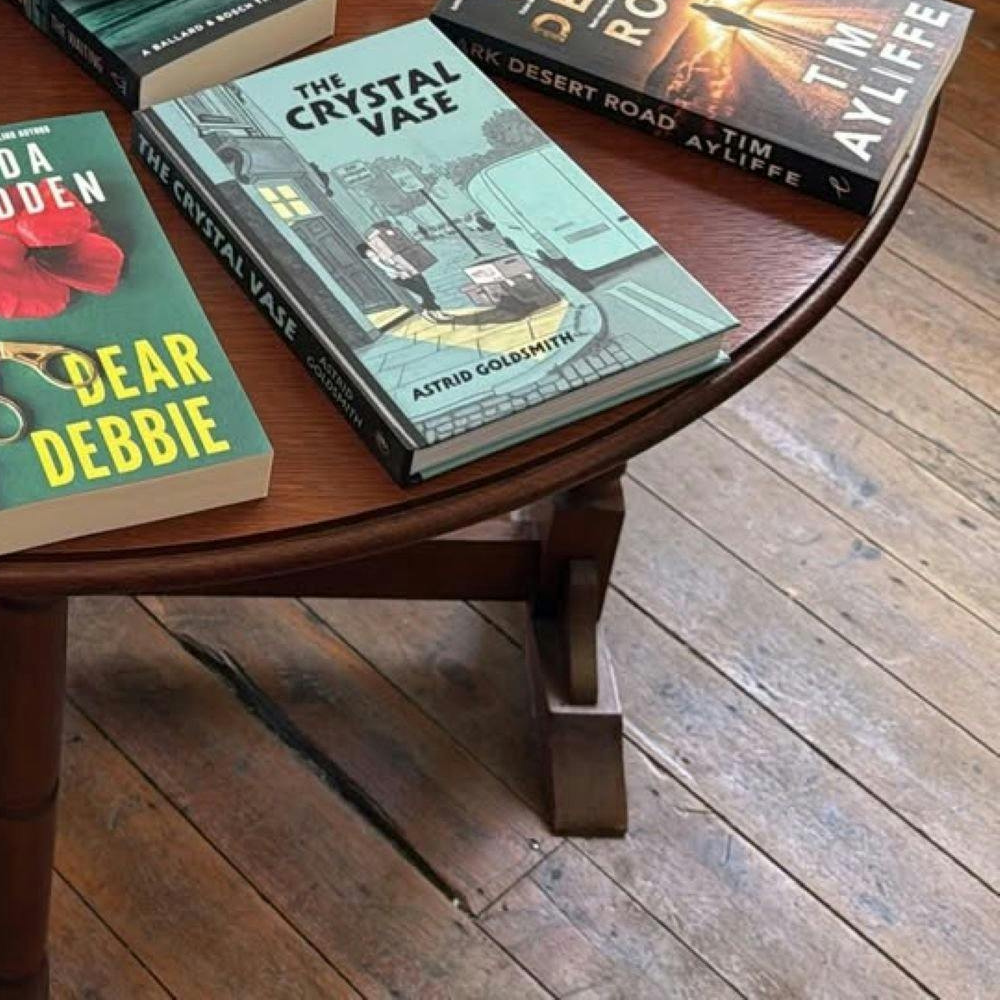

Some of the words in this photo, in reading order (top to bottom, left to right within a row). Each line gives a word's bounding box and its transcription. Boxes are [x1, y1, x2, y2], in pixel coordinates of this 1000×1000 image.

[141, 47, 152, 58] A
[152, 25, 205, 55] BALLARD
[215, 3, 254, 24] BOSCH
[803, 20, 881, 91] TIM
[285, 60, 462, 133] CRYSTAL
[293, 72, 347, 101] THE
[356, 90, 460, 139] VASE
[459, 37, 501, 67] ARK
[507, 57, 599, 102] DESERT
[604, 93, 676, 131] ROAD
[832, 1, 952, 163] AYLIFFE
[18, 124, 51, 139] AUTHOR
[684, 134, 801, 188] AYLIFFE
[721, 127, 773, 158] TIM
[136, 132, 172, 184] THE
[172, 182, 247, 279] CRYSTAL
[250, 270, 298, 341] VASE
[63, 332, 212, 408] DEAR
[306, 355, 364, 428] GOLDSMITH
[318, 355, 355, 401] ASTRID
[410, 366, 473, 402] ASTRID
[475, 330, 577, 377] GOLDSMITH
[30, 396, 231, 489] DEBBIE
